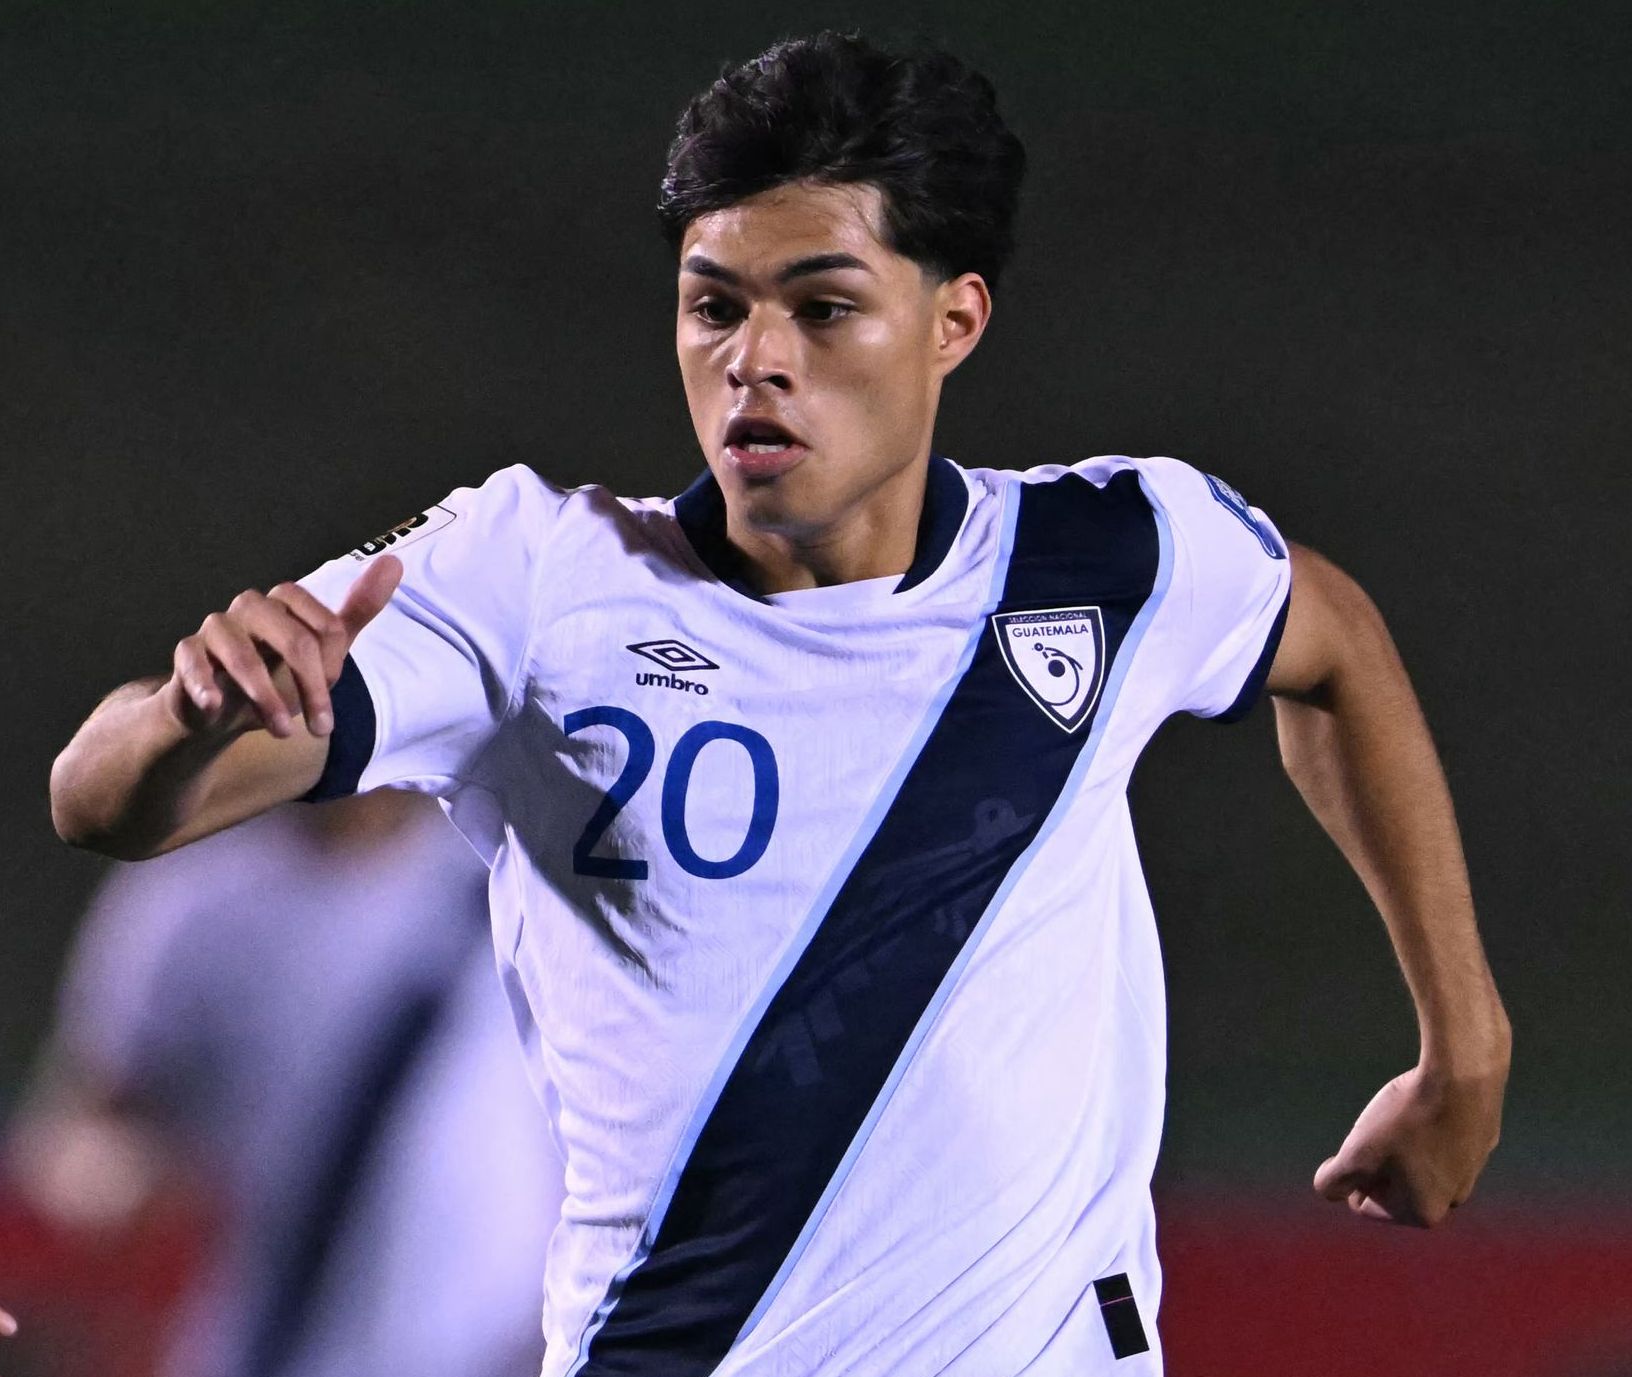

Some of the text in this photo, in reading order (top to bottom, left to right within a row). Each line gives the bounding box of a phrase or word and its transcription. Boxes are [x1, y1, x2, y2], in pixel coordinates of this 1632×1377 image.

[1012, 623, 1089, 638] GUATEMALA
[635, 673, 709, 696] umbro
[564, 706, 779, 880] 20
